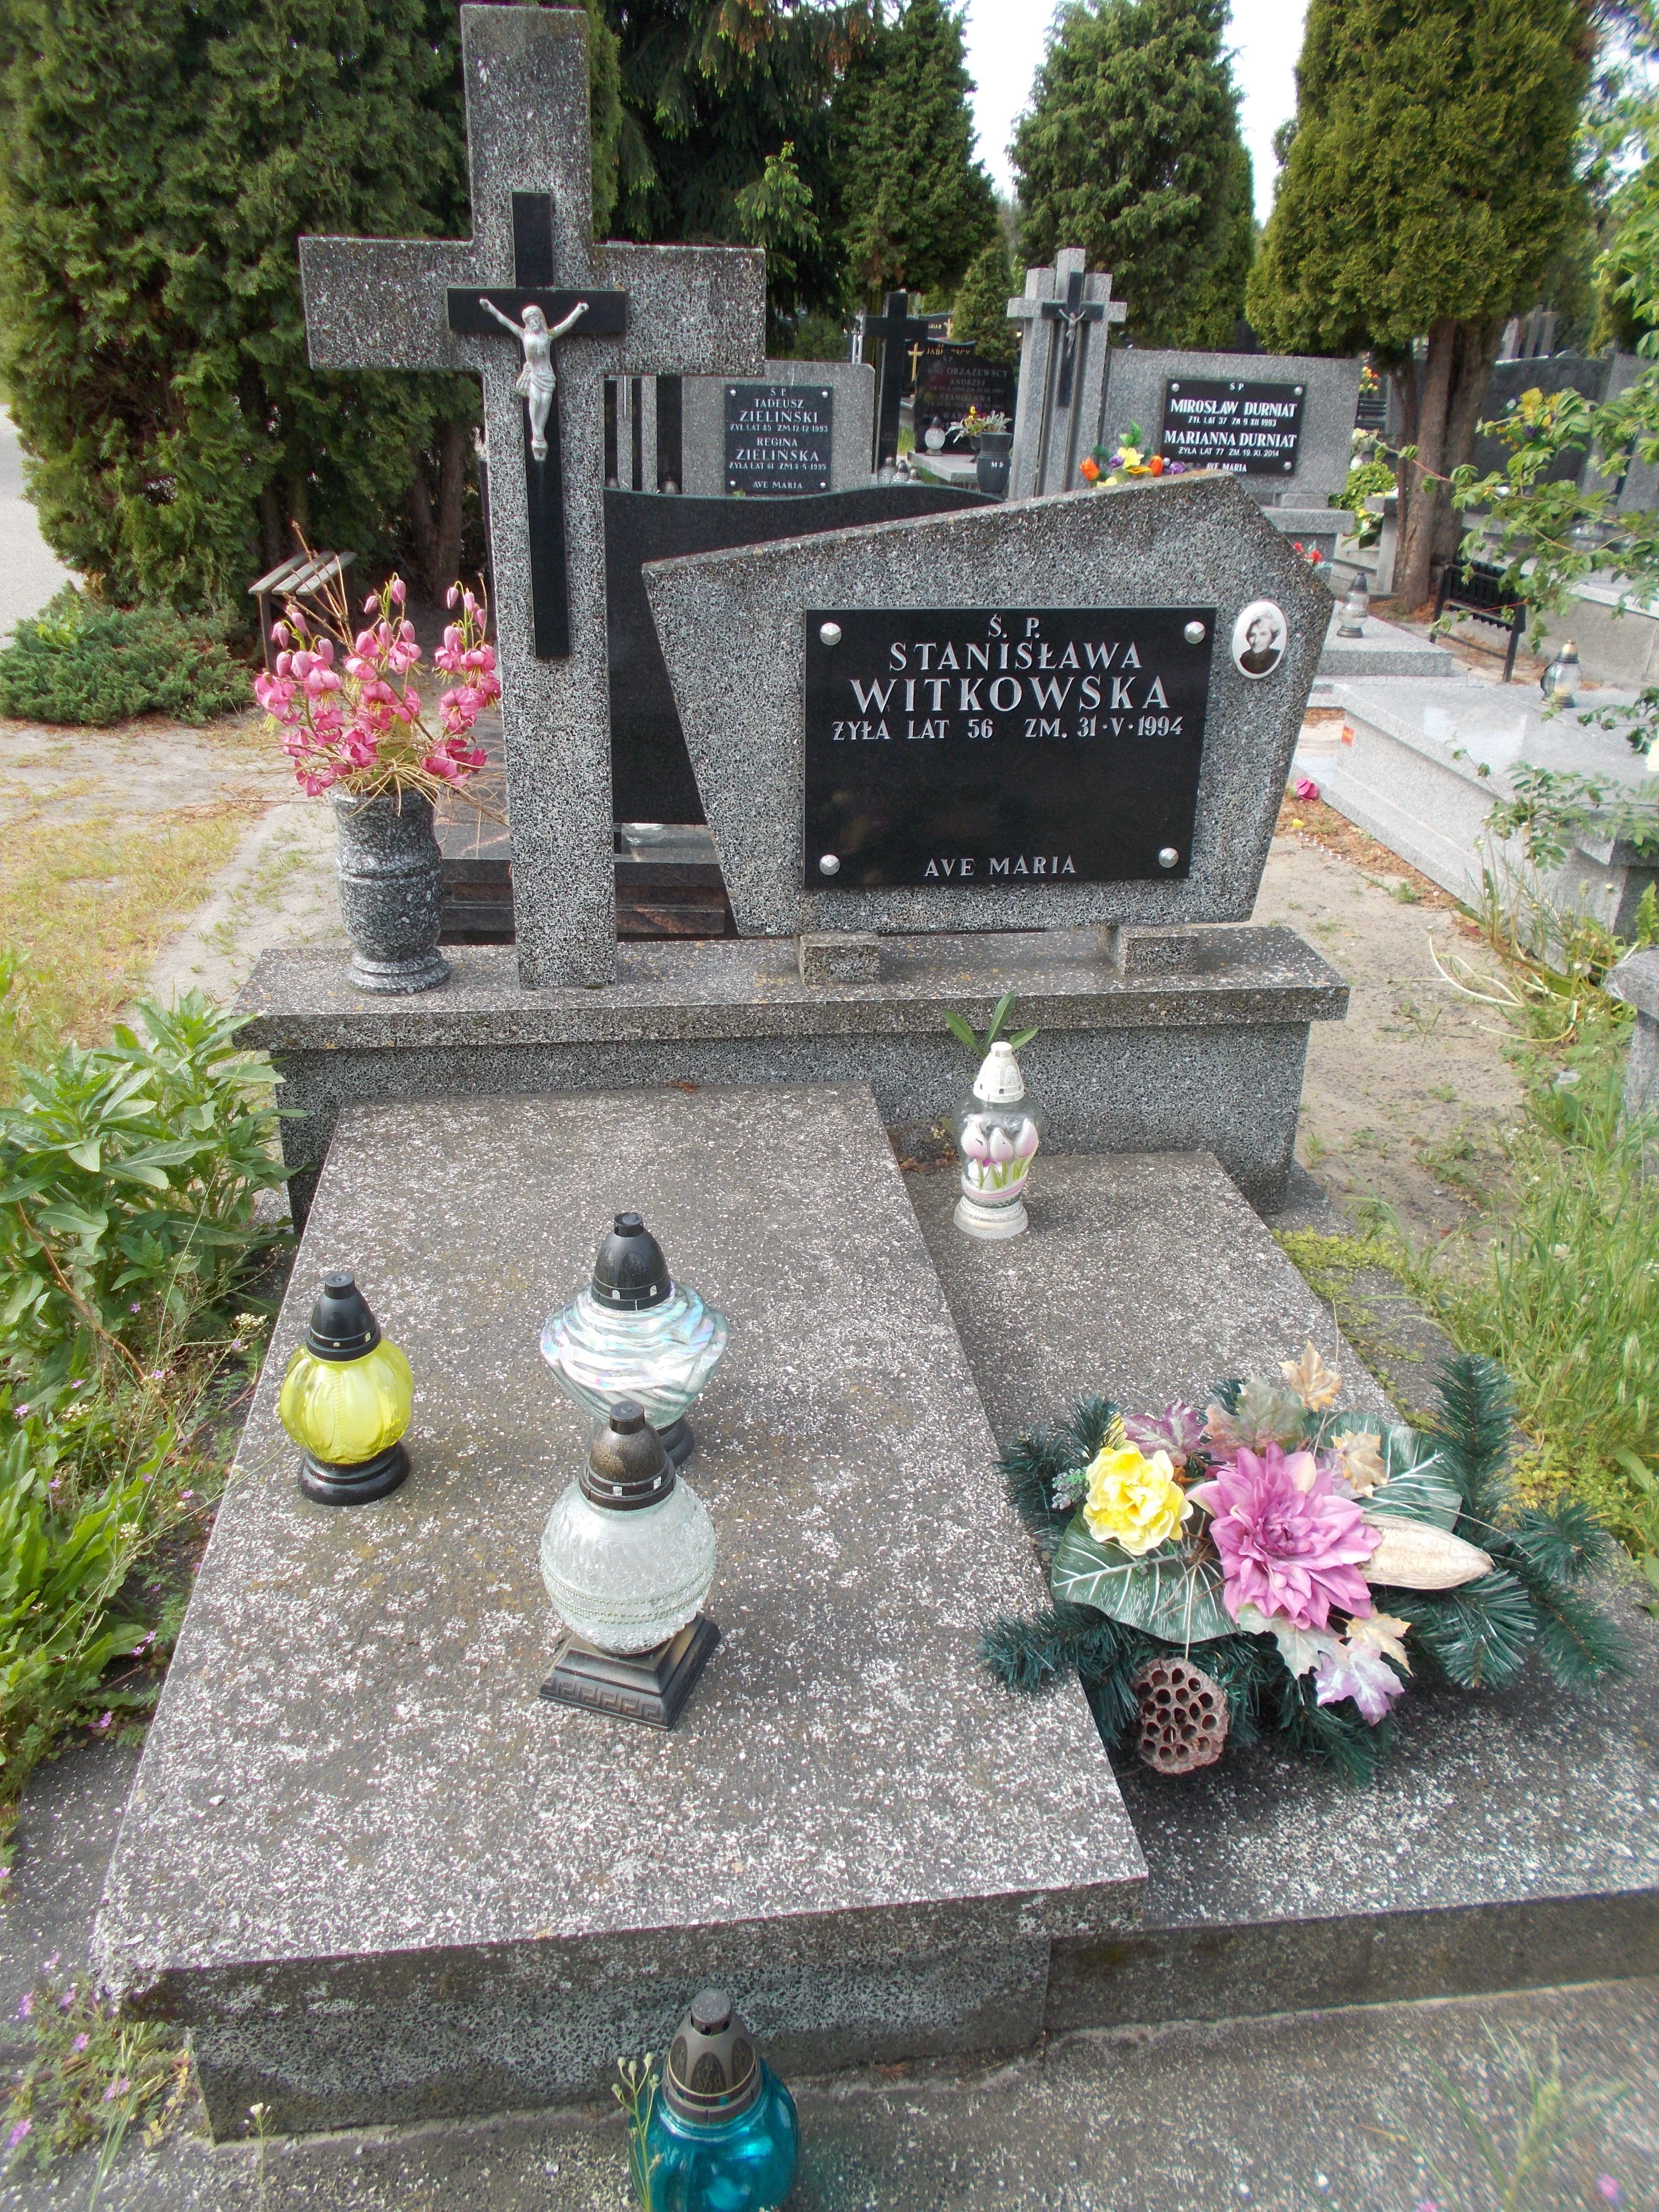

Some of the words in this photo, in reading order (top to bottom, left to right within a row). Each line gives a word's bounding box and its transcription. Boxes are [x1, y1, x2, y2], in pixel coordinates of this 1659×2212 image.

[755, 398, 805, 409] TADEUSZ
[1170, 399, 1239, 414] MIROSŁAW
[1243, 402, 1298, 417] DURNIAT
[739, 409, 818, 423] ZIELIŃSKI
[757, 437, 798, 446] REGINA
[1164, 430, 1236, 445] MARIANNA
[1239, 433, 1297, 448] DURNIAT
[736, 448, 819, 461] ZIELIŃSKA
[1200, 447, 1213, 455] LAT
[1222, 462, 1247, 472] MARIA
[1025, 617, 1040, 638] P.
[889, 641, 1143, 671] STANISŁAWA
[850, 675, 1170, 714] WITKOWSKA
[907, 718, 950, 739] LAT
[967, 719, 994, 738] 56
[1024, 718, 1068, 738] ZM.
[924, 858, 975, 878] AVE
[989, 854, 1077, 876] MARIA
